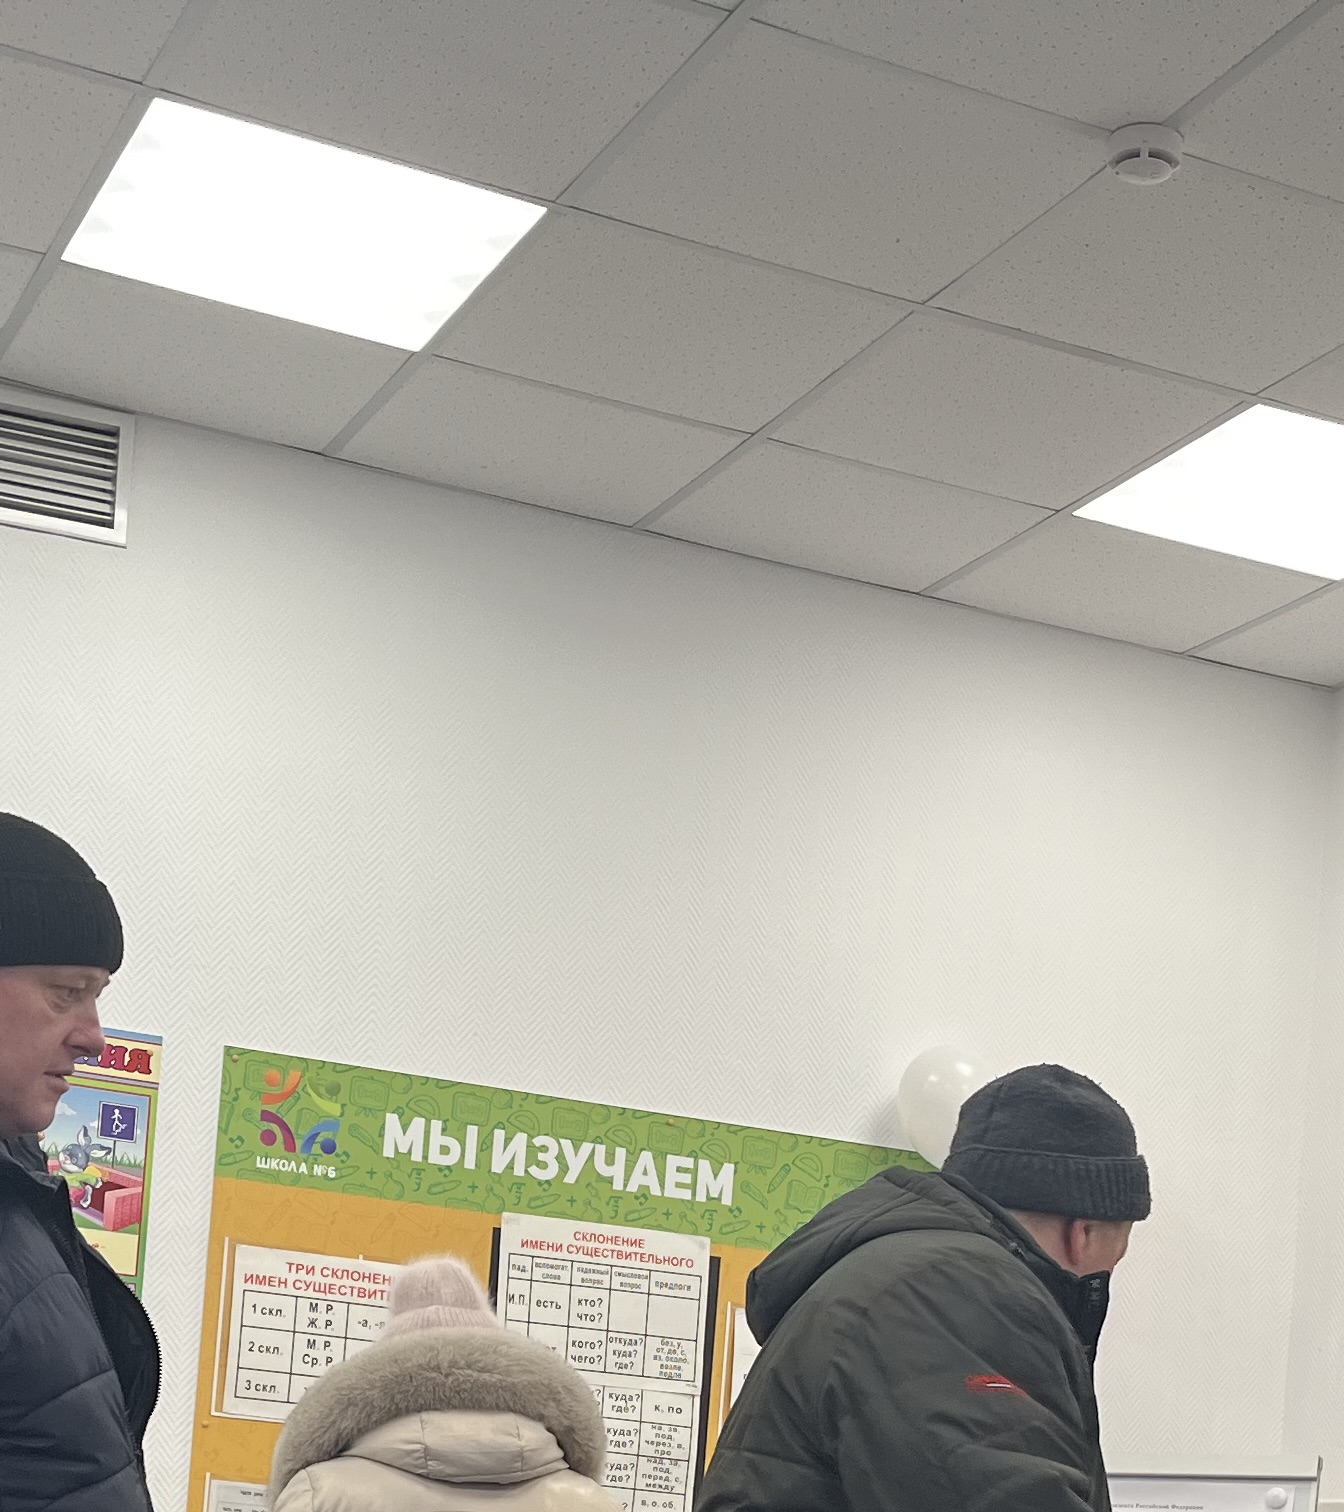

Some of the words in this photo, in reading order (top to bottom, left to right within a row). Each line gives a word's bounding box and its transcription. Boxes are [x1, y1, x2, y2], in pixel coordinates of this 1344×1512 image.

[383, 1113, 475, 1170] МЫ
[492, 1128, 736, 1207] ИЗУЧАЕМ
[256, 1155, 308, 1177] ШКОЛА
[312, 1163, 337, 1179] №6
[573, 1231, 645, 1249] СКЛОНЕНИЕ
[521, 1239, 563, 1253] ИМЕНИ
[566, 1245, 694, 1269] СУЩЕСТВИТЕЛЬНОГО
[286, 1262, 315, 1276] ТРИ
[320, 1266, 394, 1286] СКЛОНЕН
[244, 1273, 288, 1288] ИМЕН
[292, 1279, 389, 1301] СУЩЕСТВИТ
[536, 1299, 562, 1310] есть
[577, 1298, 604, 1309] кто?
[260, 1306, 286, 1318] скл.
[577, 1312, 603, 1324] что?
[258, 1344, 283, 1356] скл.
[572, 1340, 603, 1351] кого?
[609, 1336, 643, 1347] откуда?
[571, 1354, 603, 1366] чего?
[612, 1349, 637, 1359] куда?
[614, 1361, 634, 1371] где?
[255, 1382, 280, 1394] скл.
[609, 1392, 640, 1402] куда?
[668, 1406, 683, 1415] по
[612, 1405, 636, 1413] где?
[607, 1427, 638, 1437] куда?
[610, 1440, 634, 1448] где?
